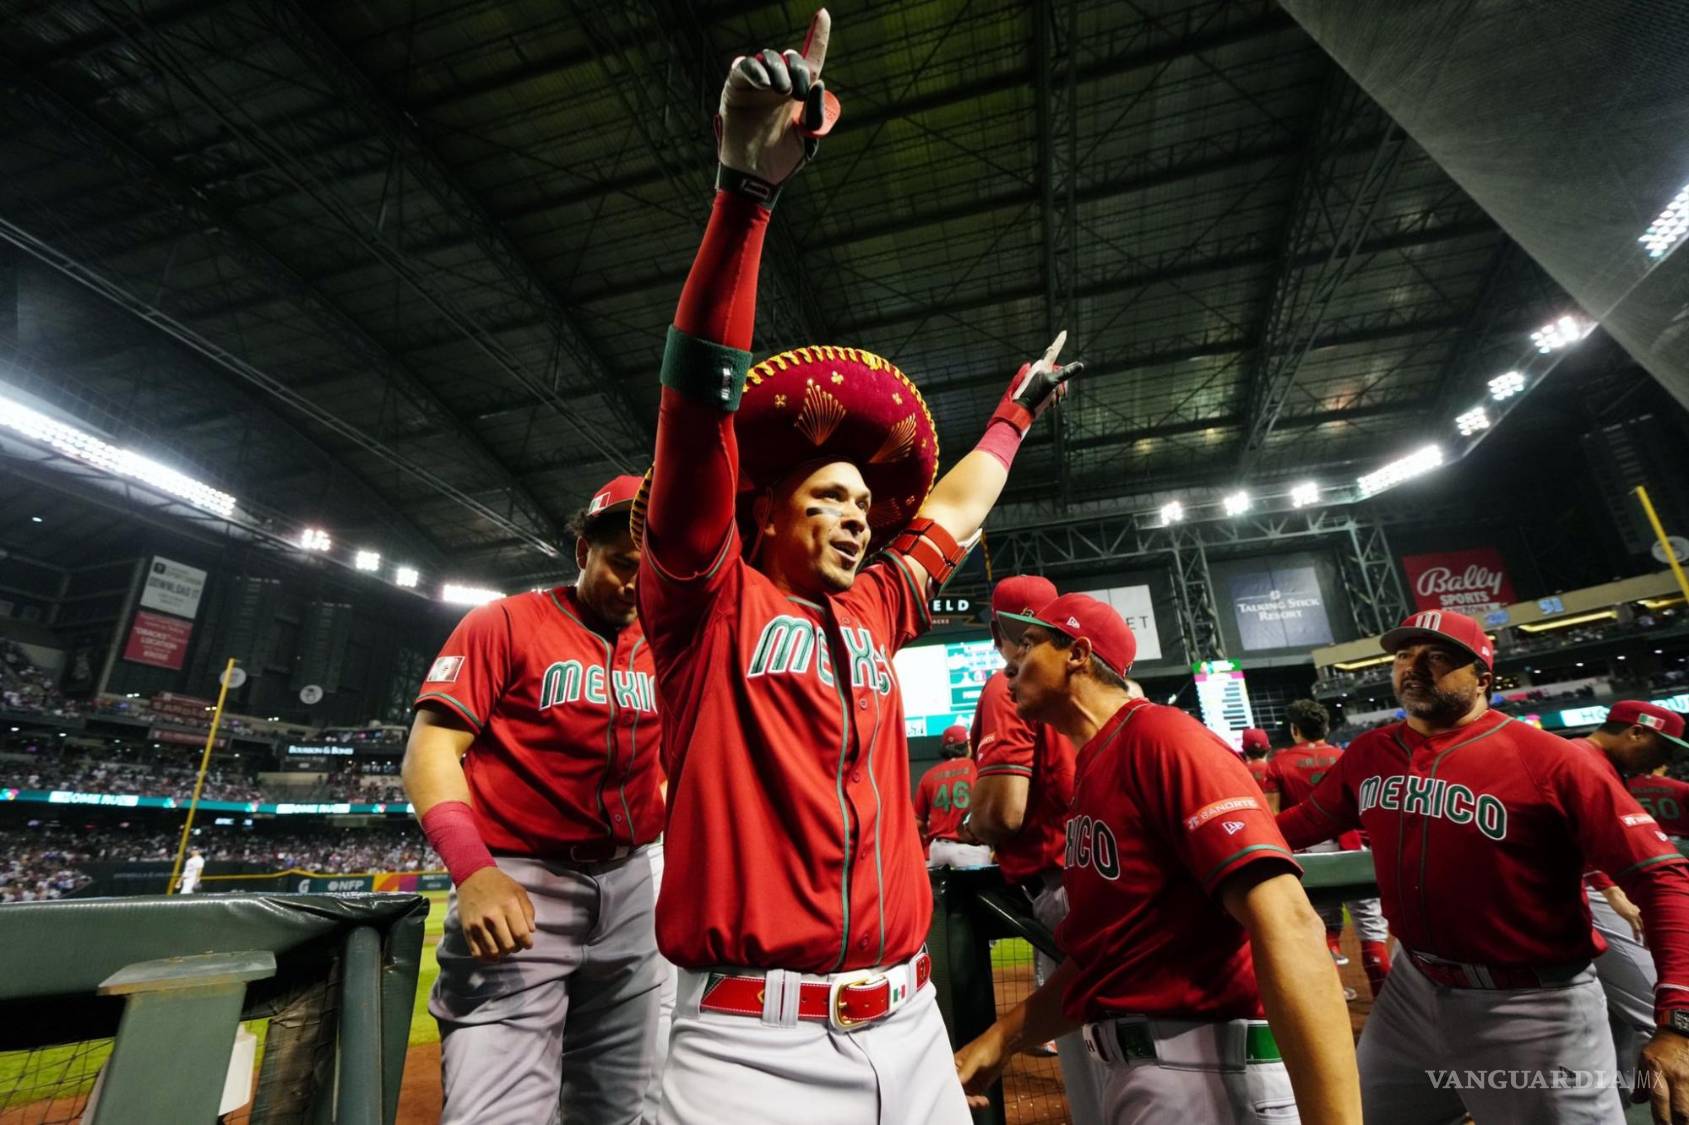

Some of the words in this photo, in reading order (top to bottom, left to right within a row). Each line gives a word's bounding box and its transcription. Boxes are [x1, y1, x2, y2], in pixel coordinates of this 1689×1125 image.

[148, 576, 192, 597] DOWNLOAD
[1417, 564, 1503, 596] Bally
[932, 599, 970, 612] ELD
[1237, 600, 1286, 614] TALKING
[1287, 598, 1321, 608] STICK
[1440, 591, 1491, 606] SPORTS
[1126, 615, 1148, 630] ET
[1258, 610, 1303, 621] RESORT
[539, 659, 659, 712] MEXI
[934, 780, 970, 812] 46
[1359, 775, 1508, 841] MEXICO
